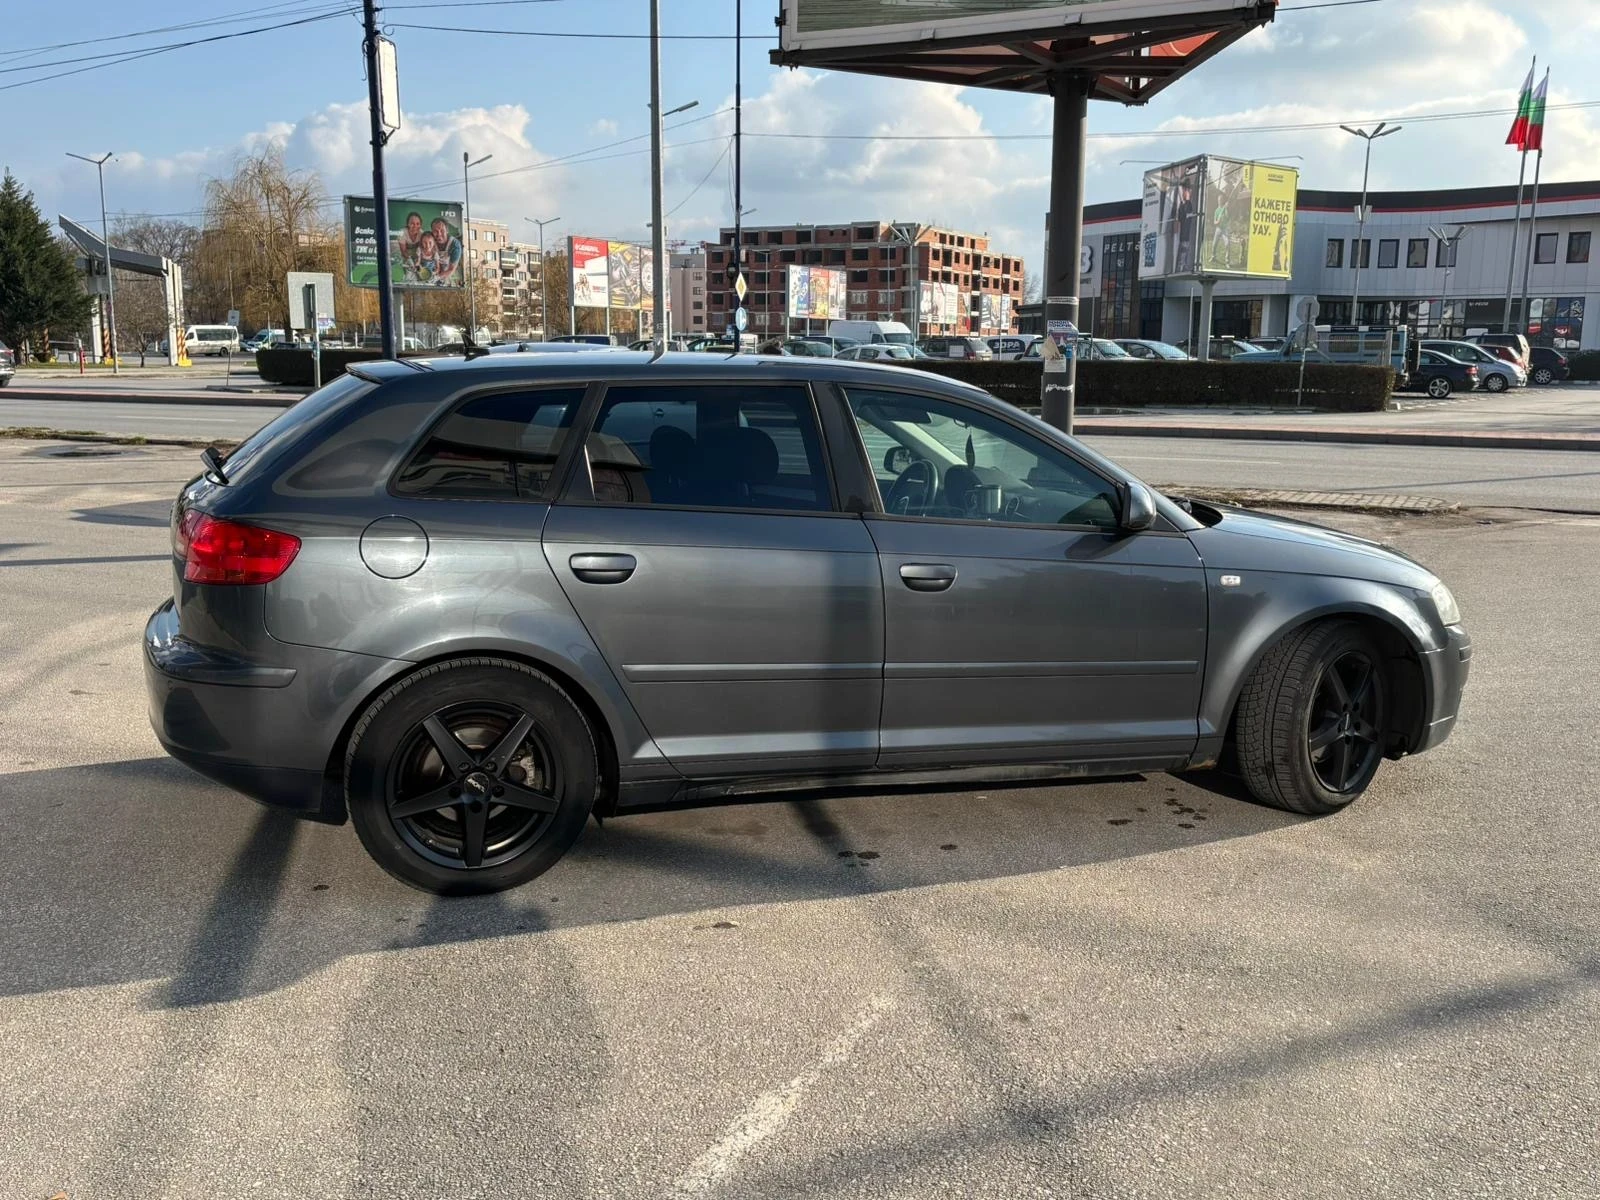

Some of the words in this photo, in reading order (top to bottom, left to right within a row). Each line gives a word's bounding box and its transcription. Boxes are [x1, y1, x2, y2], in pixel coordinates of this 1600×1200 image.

[1254, 197, 1291, 212] КАЖЕТЕ
[1253, 209, 1290, 226] ОТНОВО
[1252, 223, 1271, 236] УАУ.
